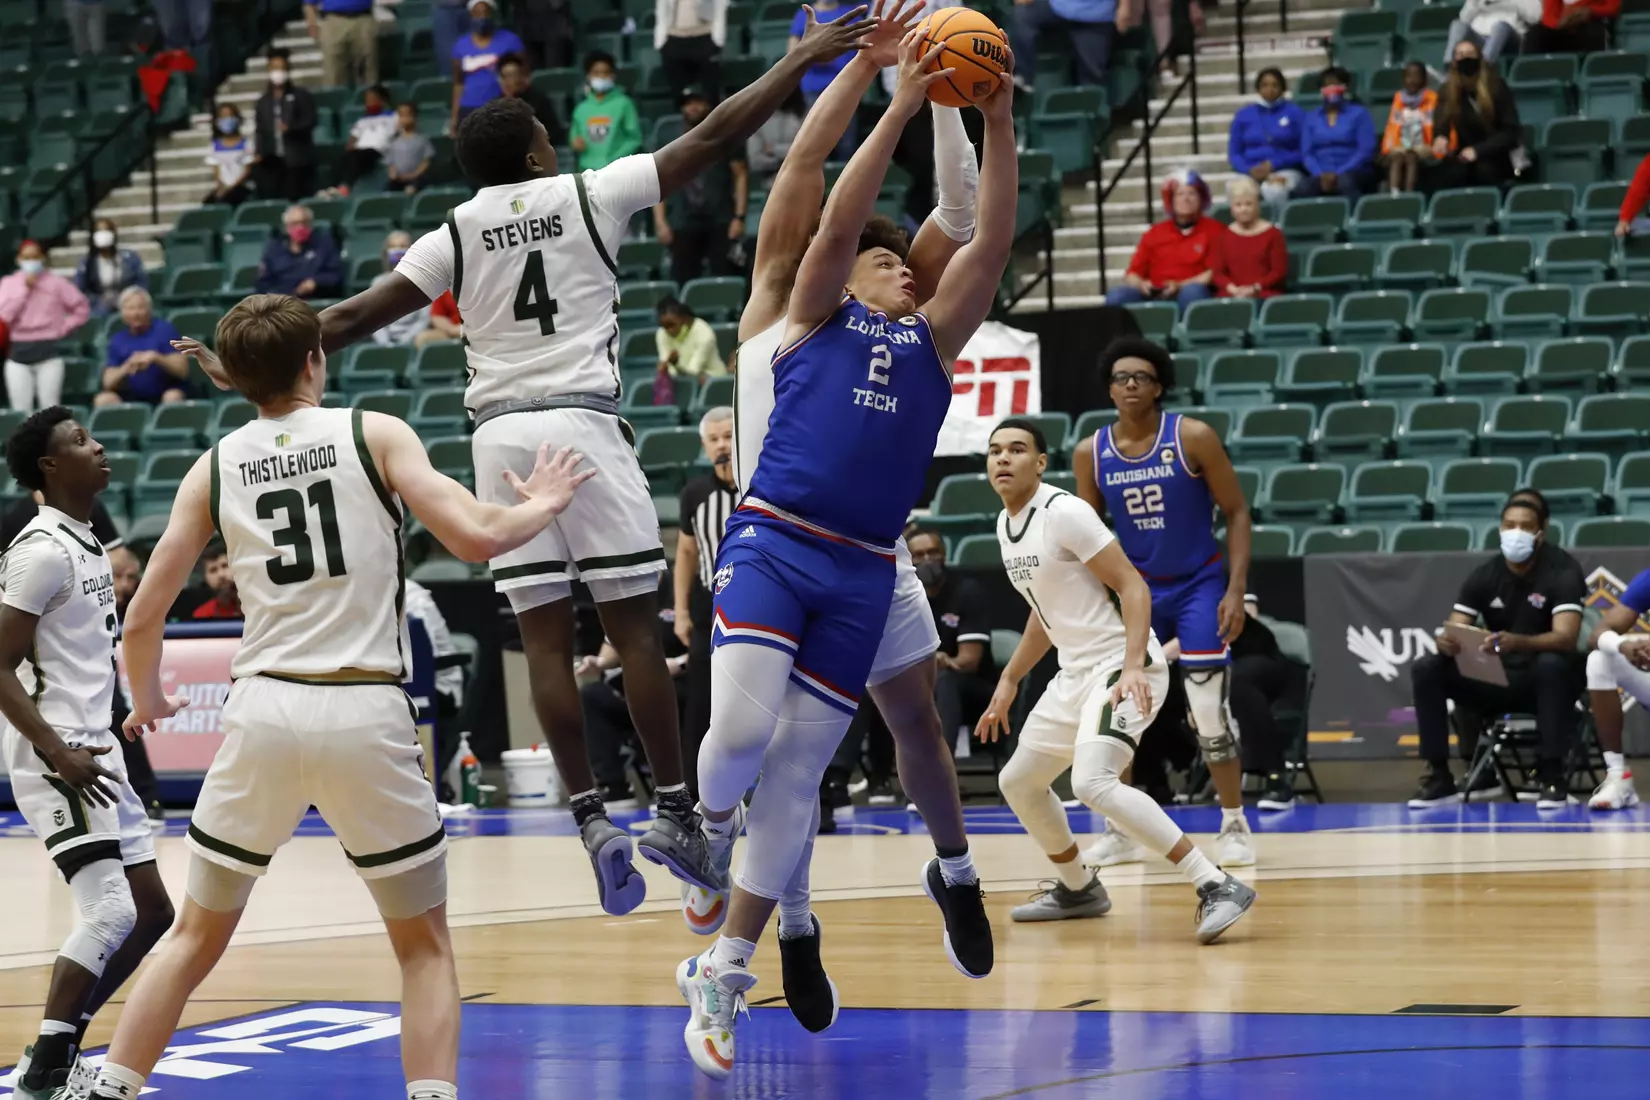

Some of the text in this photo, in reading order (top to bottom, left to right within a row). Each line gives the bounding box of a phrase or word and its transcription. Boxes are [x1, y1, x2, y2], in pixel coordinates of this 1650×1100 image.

[481, 214, 563, 252] STEVENS
[513, 249, 559, 337] 4
[867, 344, 893, 386] 2
[852, 387, 898, 413] TECH
[238, 444, 338, 487] THISTLEWOOD
[1105, 464, 1175, 486] LOUISIANA
[1122, 483, 1165, 516] 22
[255, 478, 348, 586] 31
[1133, 516, 1166, 531] TECH
[1011, 569, 1033, 583] STATE
[174, 682, 230, 708] AUTO
